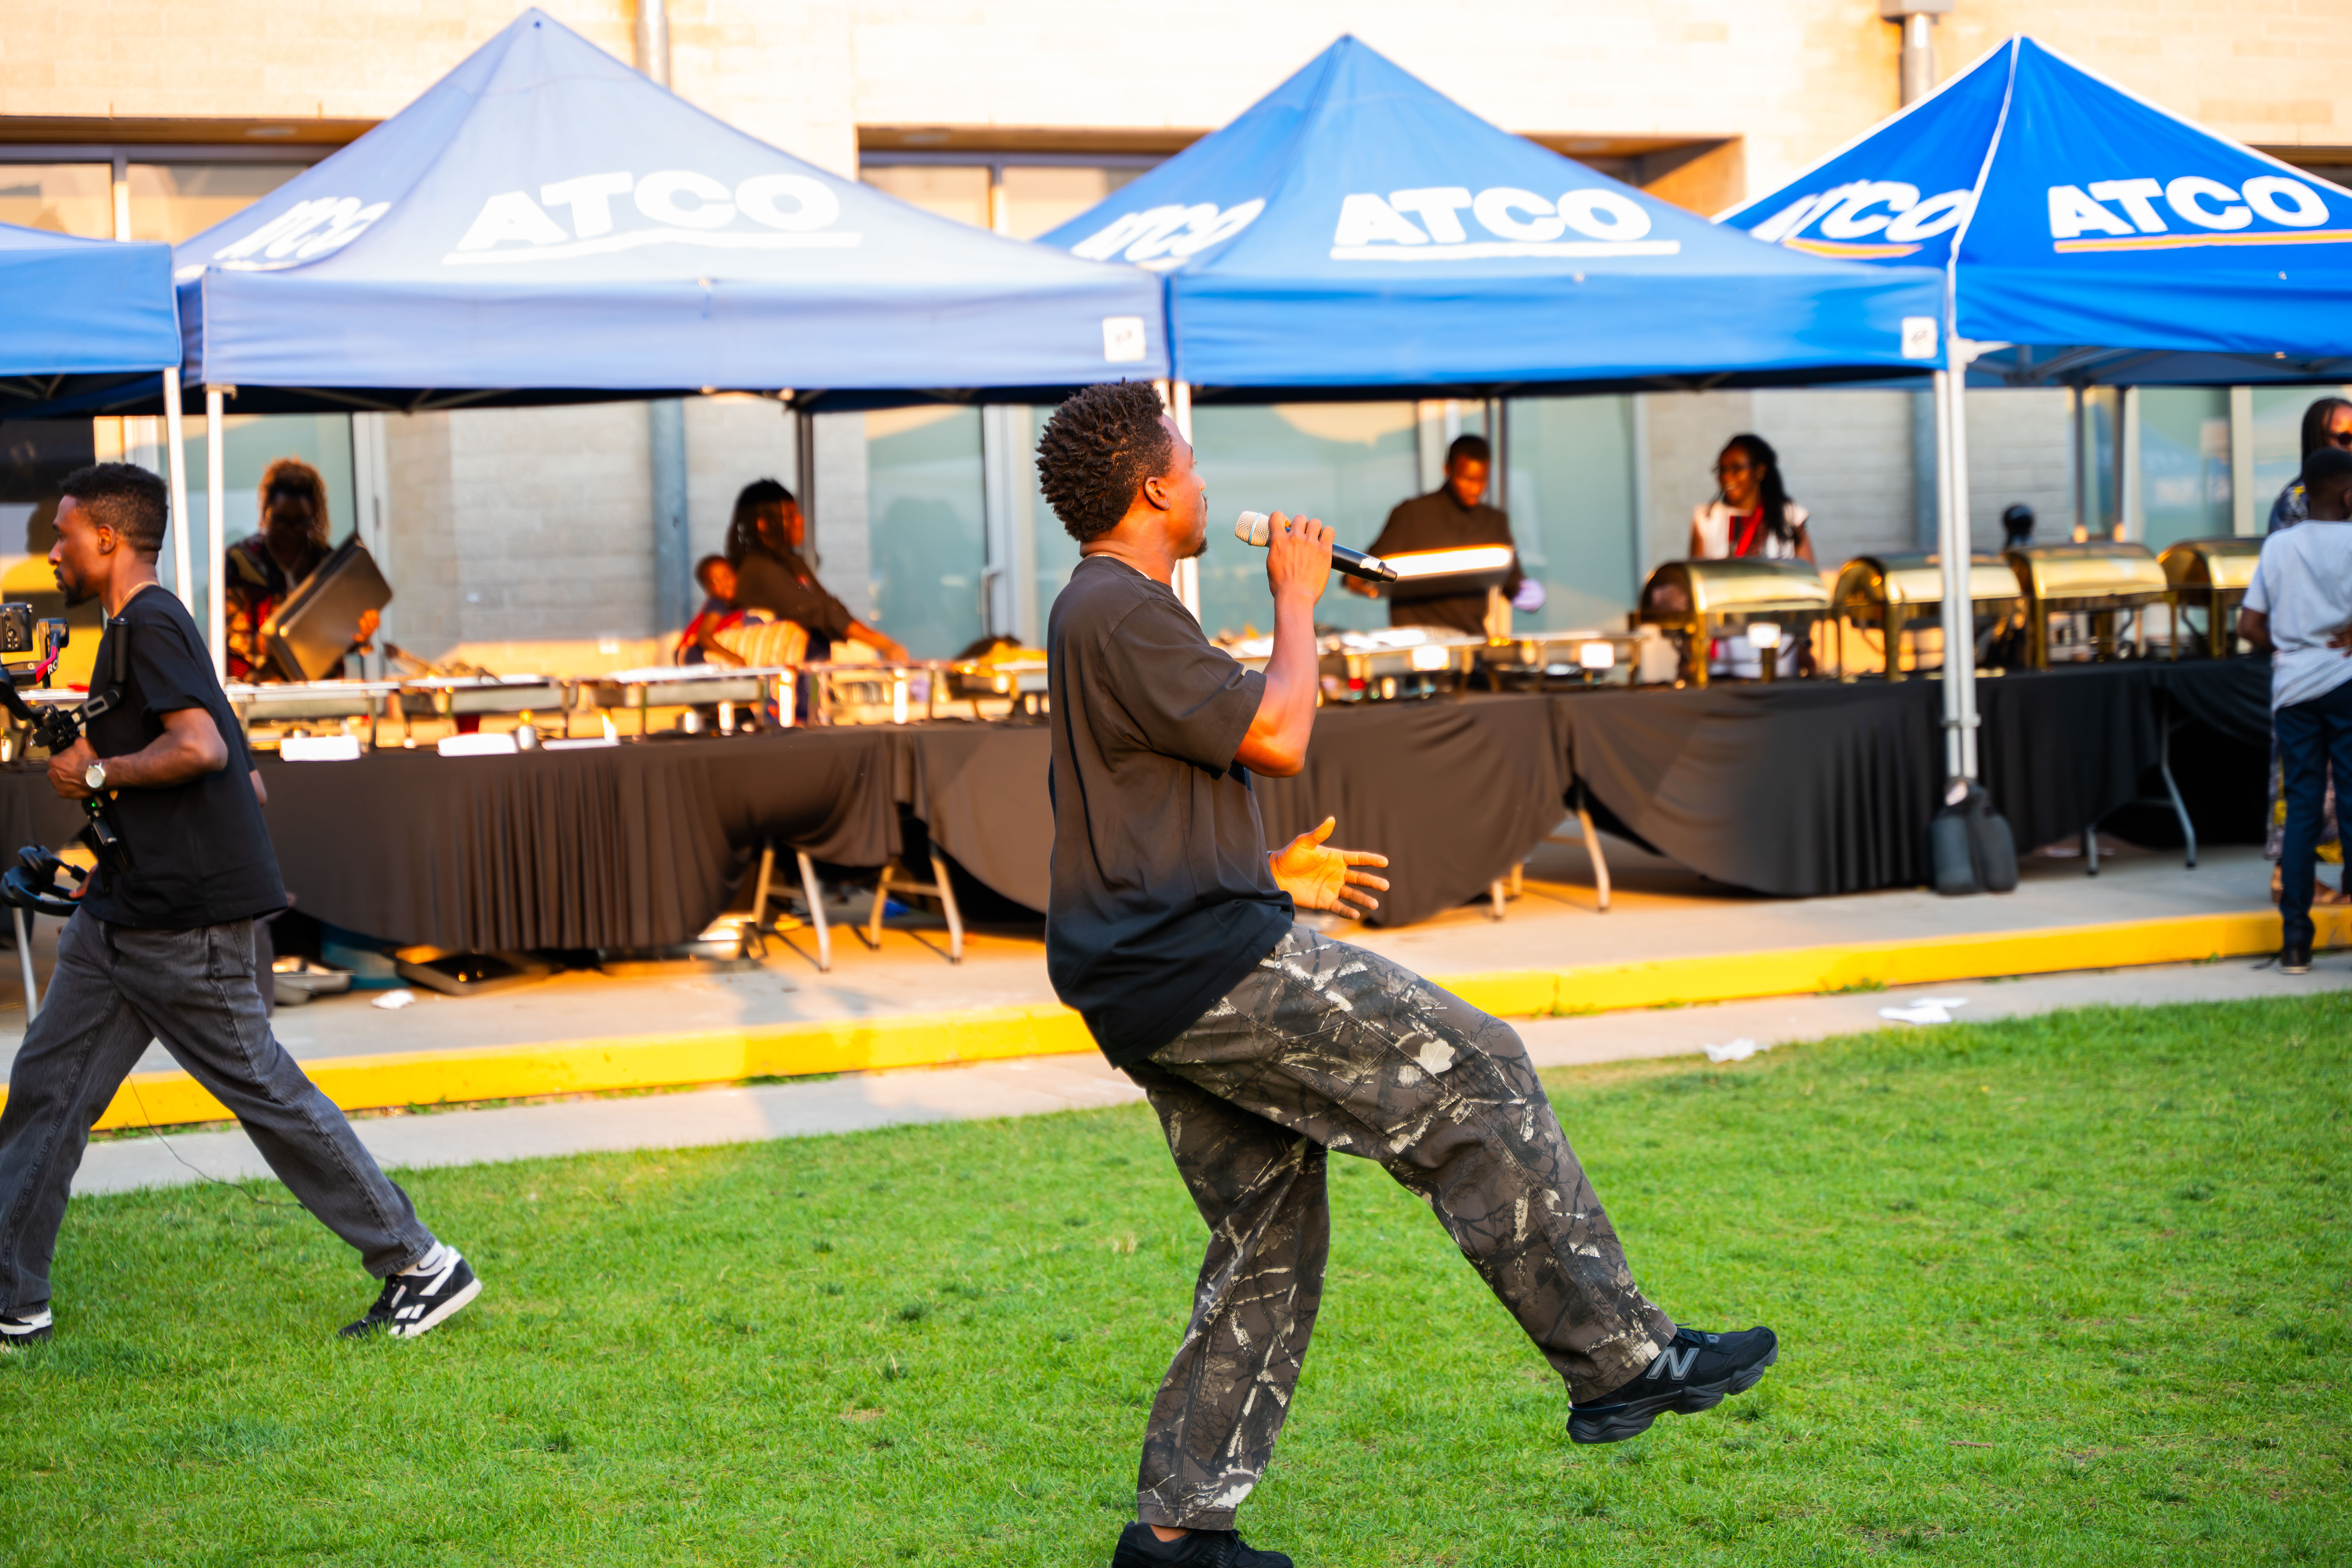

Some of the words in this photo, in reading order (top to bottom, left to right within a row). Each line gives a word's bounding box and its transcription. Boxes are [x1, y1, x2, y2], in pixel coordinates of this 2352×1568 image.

[456, 170, 840, 251] ATCO
[1334, 187, 1652, 246] ATCO
[1749, 179, 1974, 243] ATCO
[2048, 175, 2330, 239] ATCO
[1646, 1347, 1700, 1380] N
